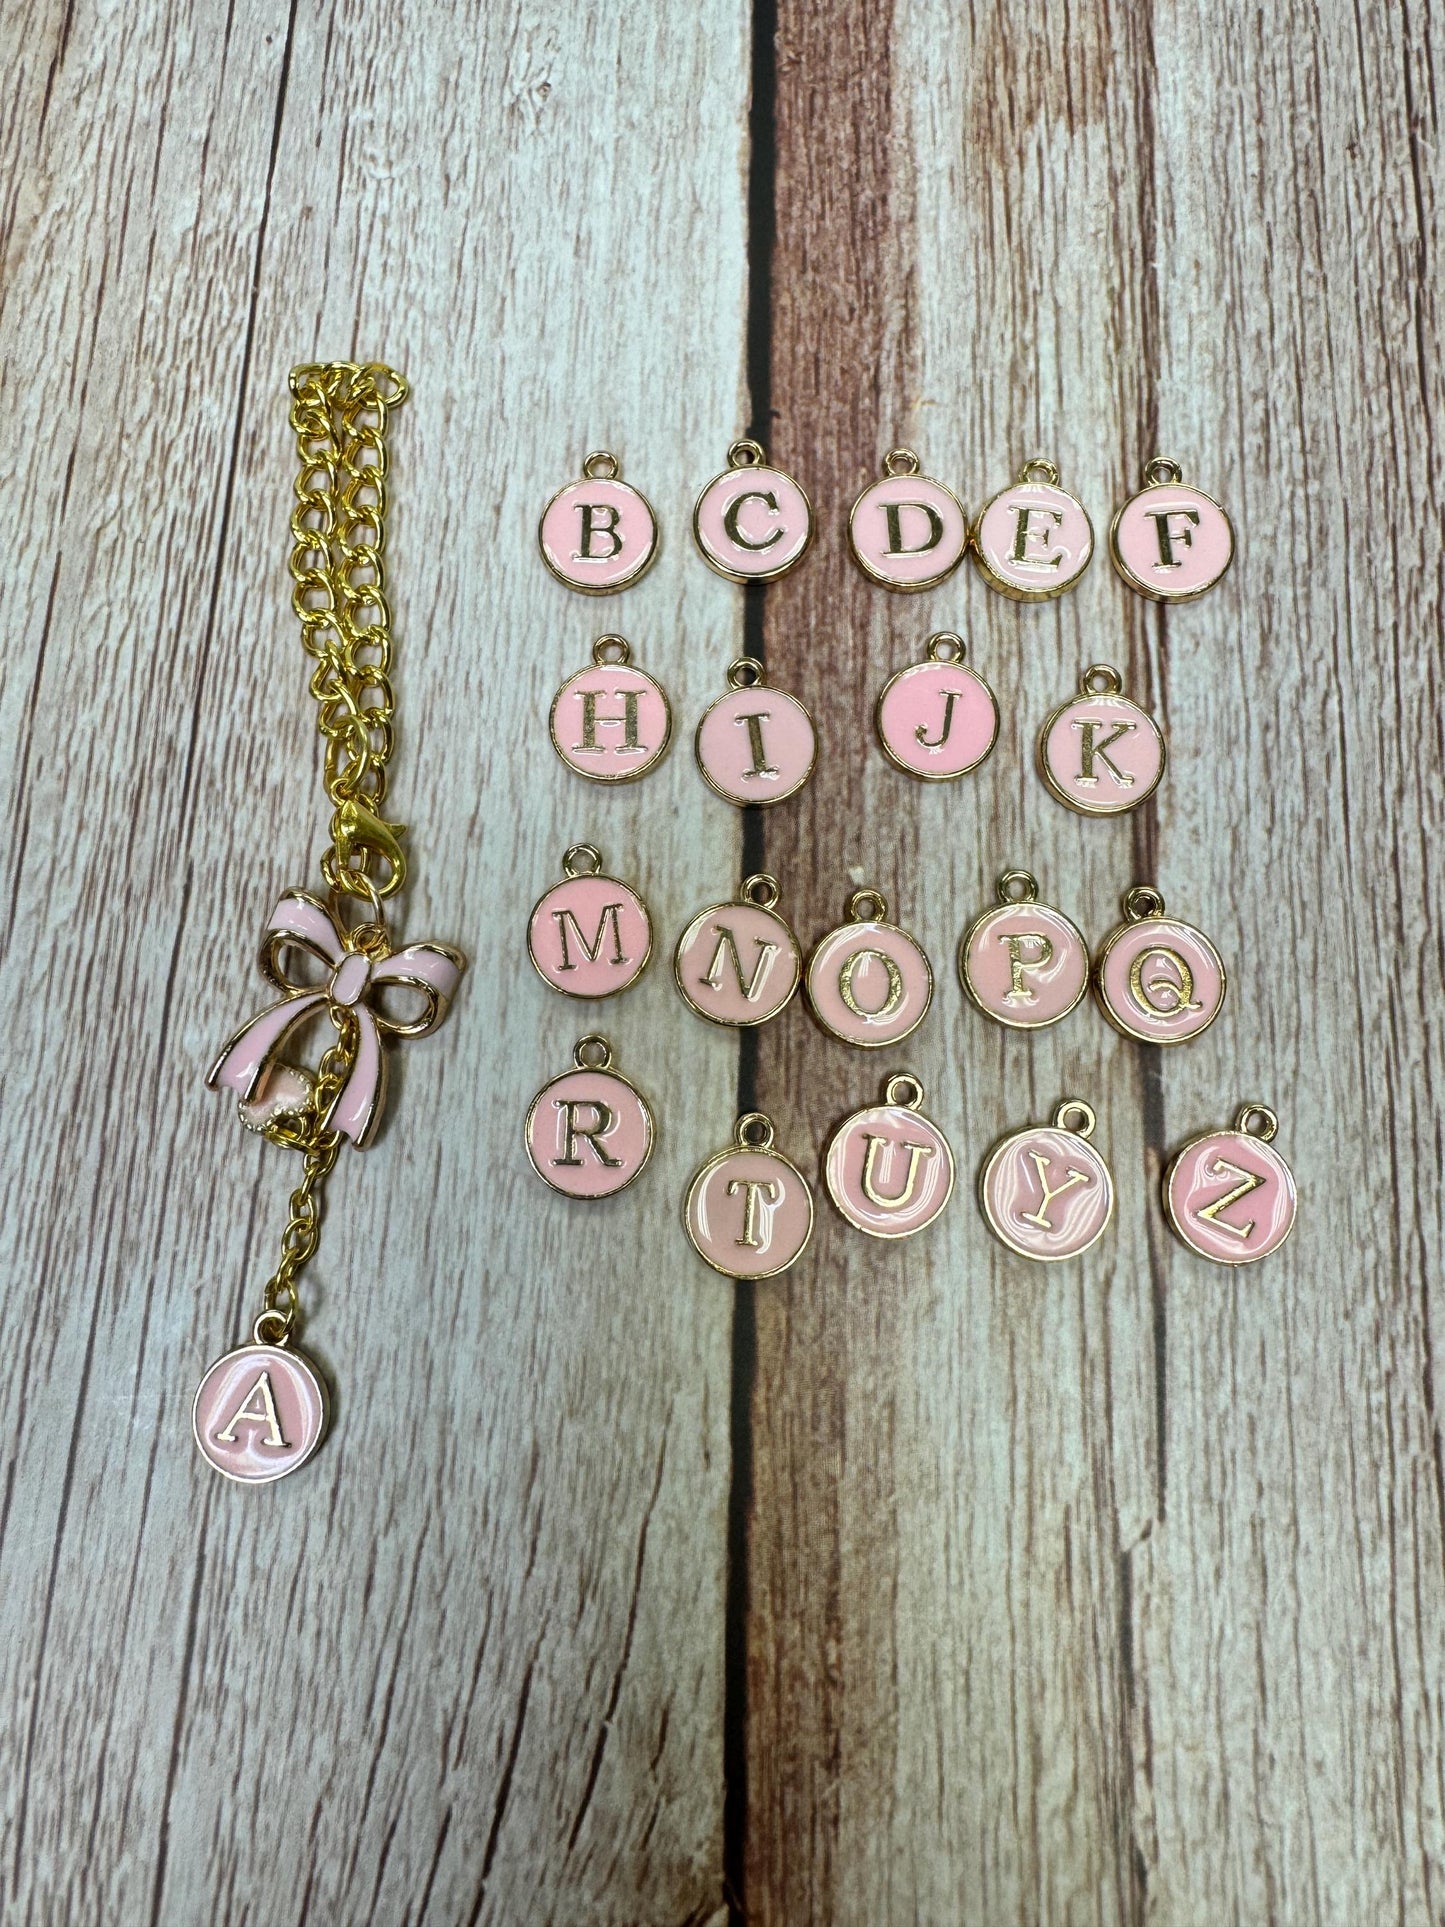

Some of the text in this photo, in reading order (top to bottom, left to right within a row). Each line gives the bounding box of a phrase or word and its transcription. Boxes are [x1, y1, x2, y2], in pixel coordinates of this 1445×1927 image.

[575, 505, 623, 562] B
[724, 491, 784, 551] C
[879, 504, 944, 554] D
[1010, 507, 1063, 570] E
[1145, 510, 1200, 569] F
[572, 689, 648, 754] H
[734, 712, 778, 779] I
[914, 689, 960, 748] J
[1071, 719, 1137, 786] K
[552, 903, 628, 972] M
[700, 925, 779, 1000] N
[998, 933, 1051, 999] P
[838, 947, 902, 1019] O
[1129, 944, 1202, 1017] Q
[552, 1100, 622, 1166] R
[863, 1133, 932, 1207] U
[1021, 1151, 1089, 1228] Y
[1198, 1158, 1266, 1238] Z
[727, 1180, 777, 1246] T
[216, 1372, 292, 1448] A
